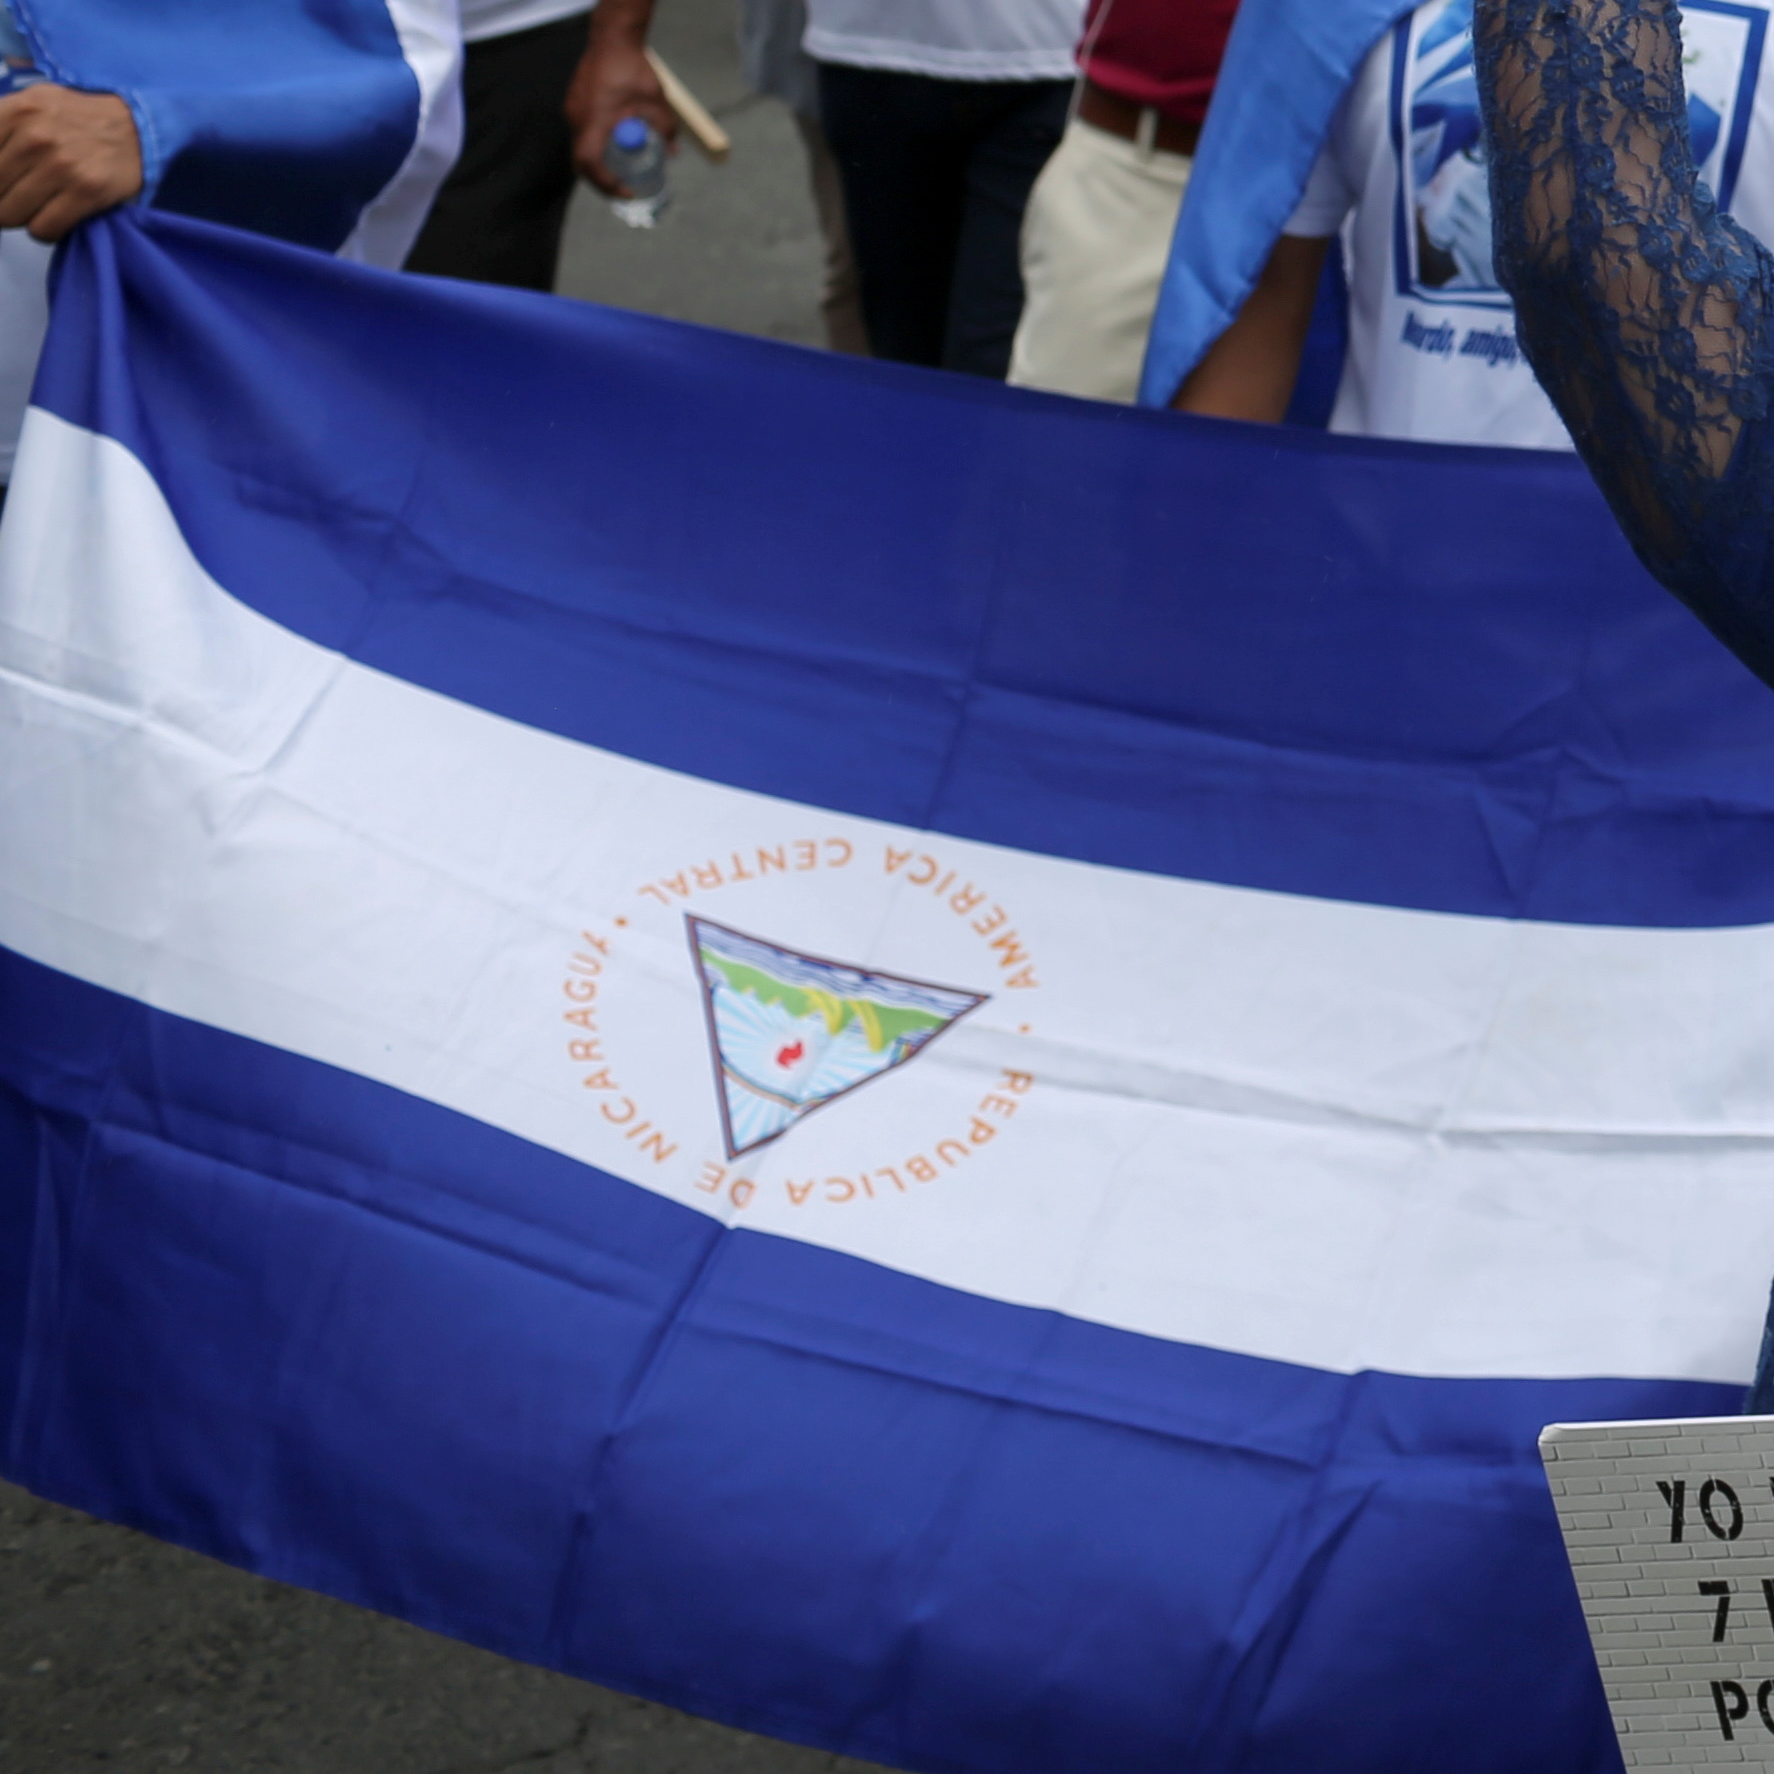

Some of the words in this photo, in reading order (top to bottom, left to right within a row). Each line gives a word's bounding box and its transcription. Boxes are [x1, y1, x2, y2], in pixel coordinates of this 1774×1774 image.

[636, 837, 854, 906] CENTRAL
[884, 844, 1041, 991] AMERICA
[561, 929, 680, 1165] NICARAGUA
[784, 1067, 1036, 1208] REPUBLICA
[693, 1160, 757, 1210] DE
[1655, 1476, 1744, 1544] YO
[1697, 1579, 1732, 1643] 7
